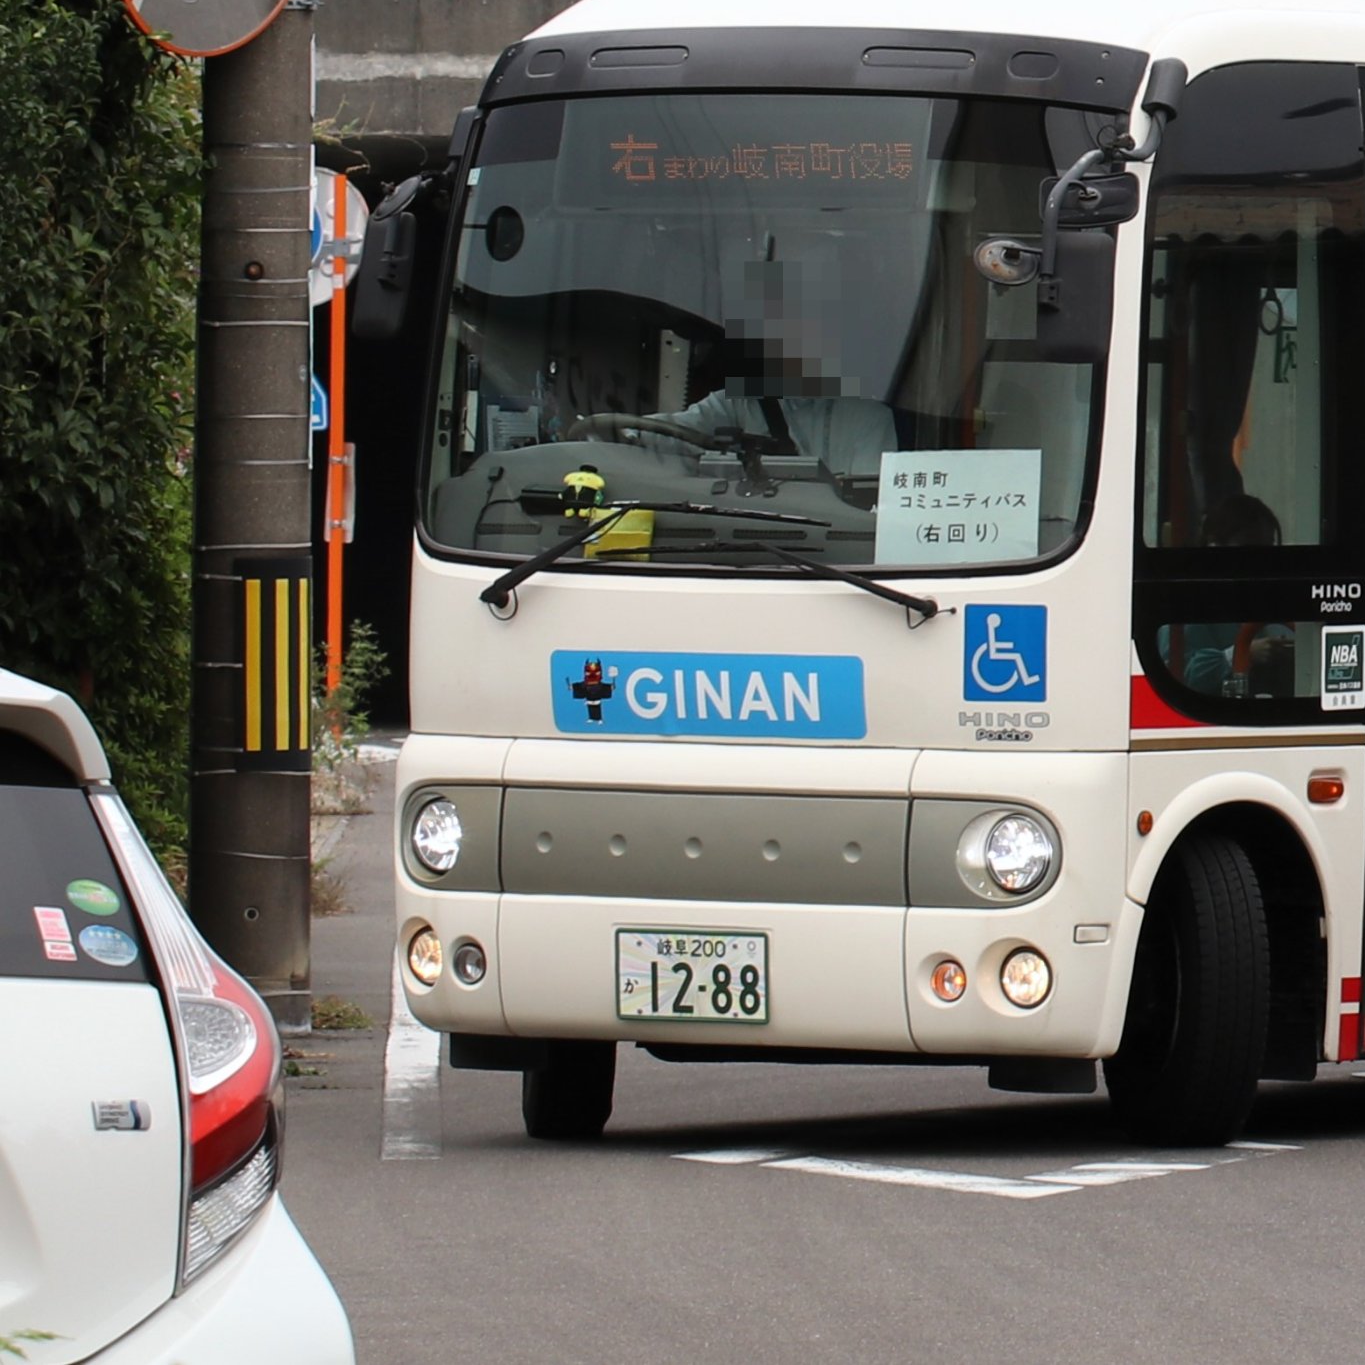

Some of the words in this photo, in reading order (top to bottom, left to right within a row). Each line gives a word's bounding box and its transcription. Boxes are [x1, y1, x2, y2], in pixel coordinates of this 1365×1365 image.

[893, 471, 949, 489] 岐南町
[899, 492, 1027, 510] コミュニティバス
[1311, 583, 1362, 599] HINO
[1330, 644, 1359, 664] NBA
[625, 667, 821, 722] GINAN
[958, 711, 1051, 729] HINO
[975, 728, 1034, 742] Poncho
[623, 977, 639, 994] か
[650, 961, 761, 1016] 12-88
